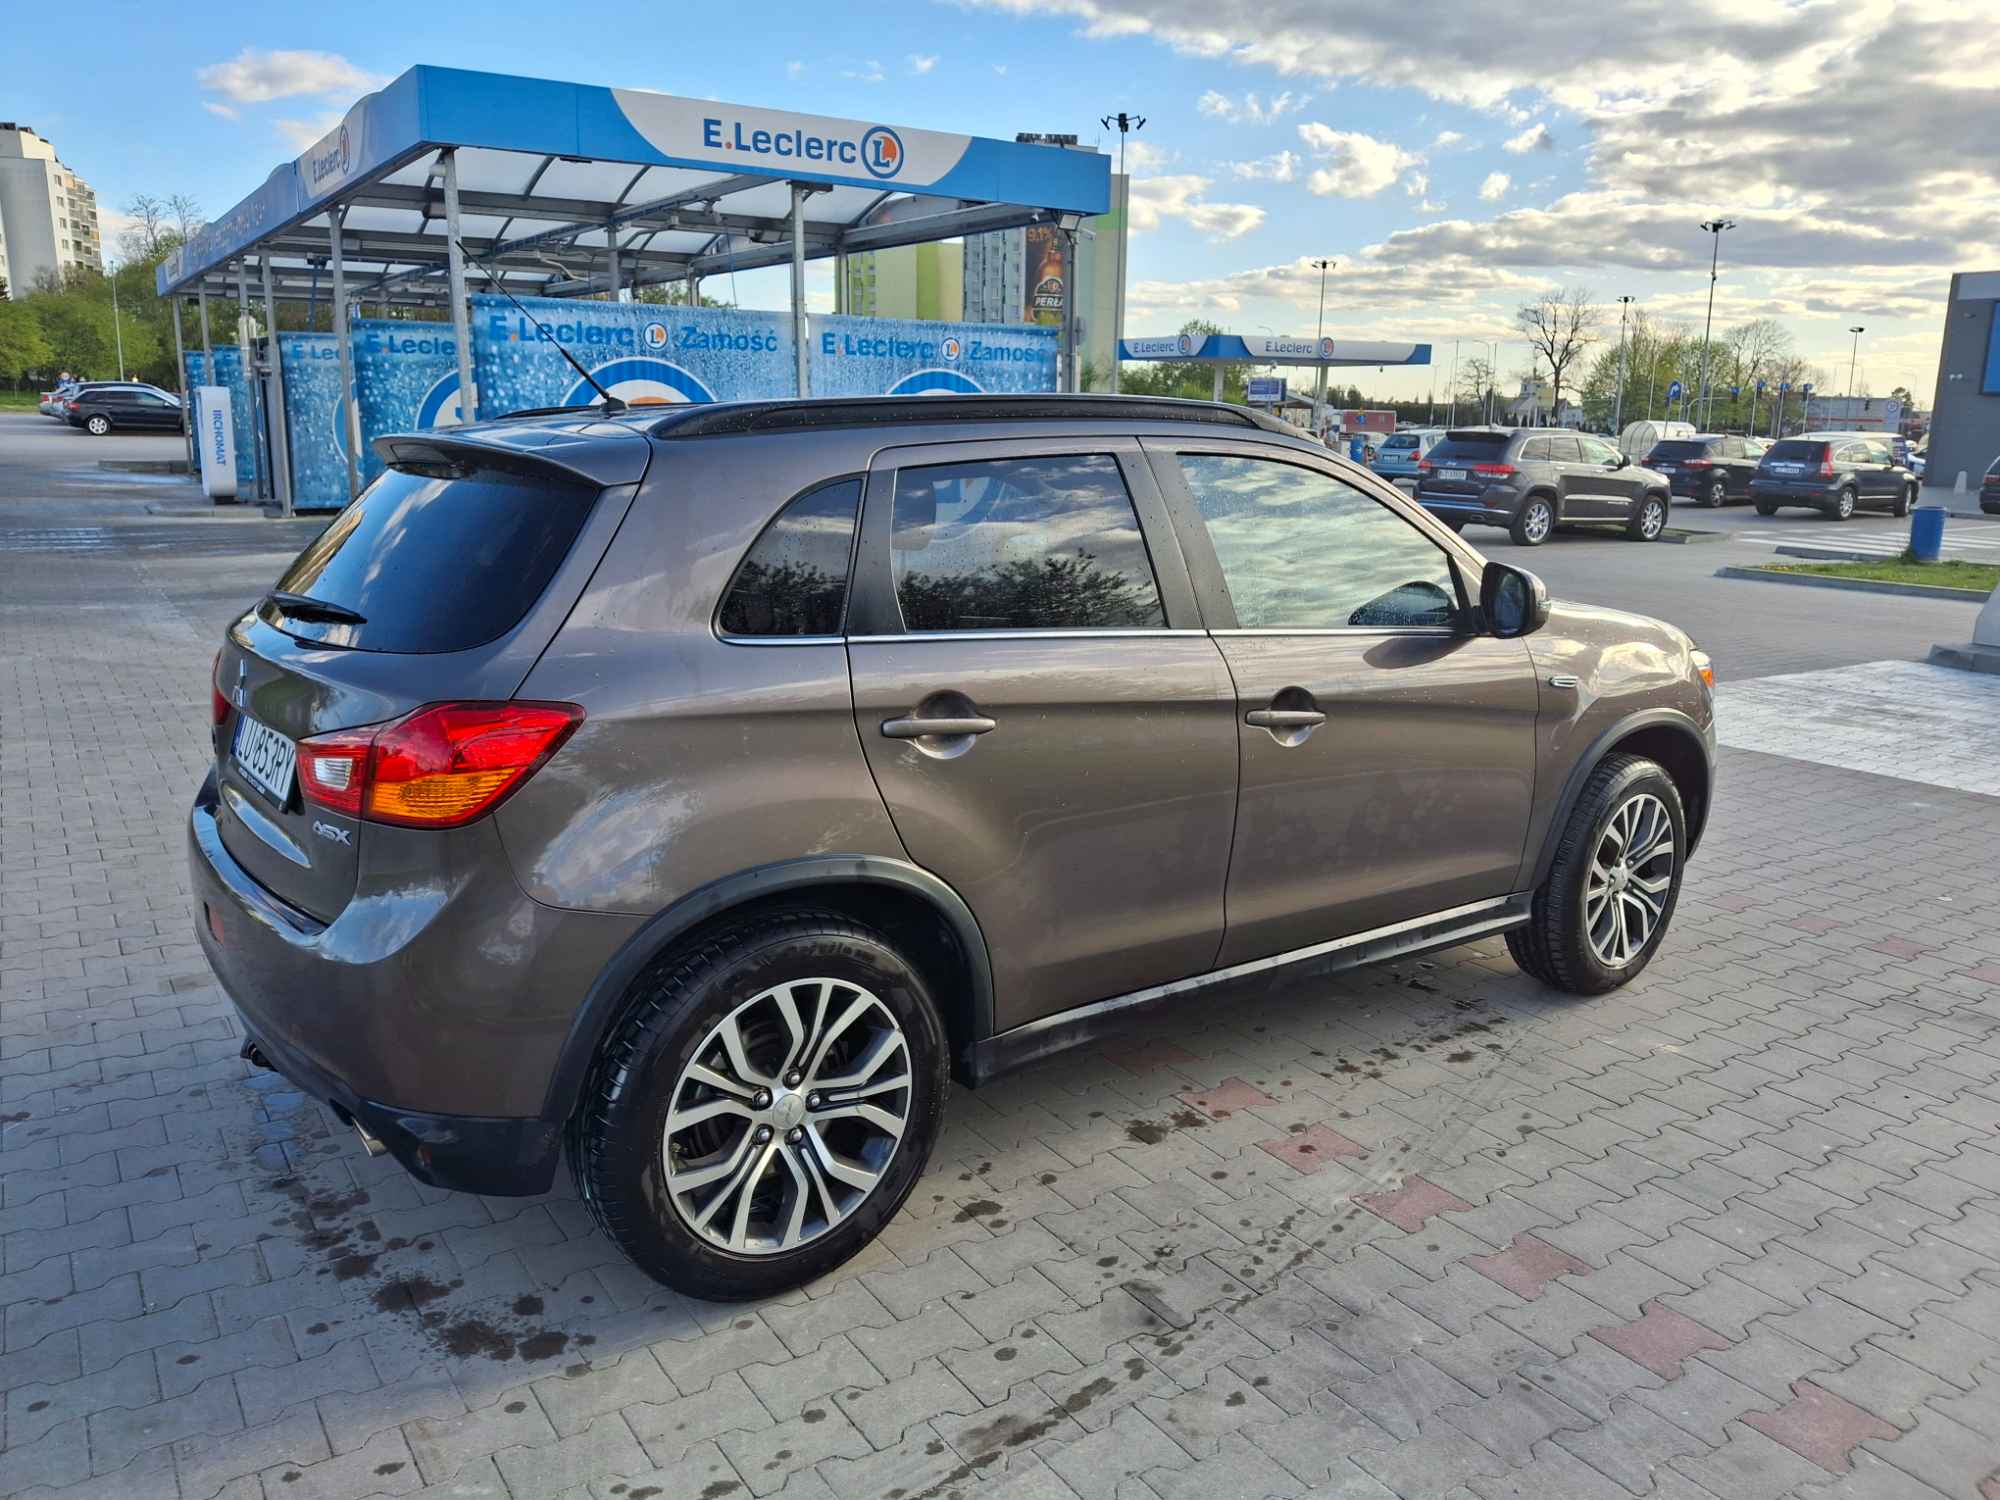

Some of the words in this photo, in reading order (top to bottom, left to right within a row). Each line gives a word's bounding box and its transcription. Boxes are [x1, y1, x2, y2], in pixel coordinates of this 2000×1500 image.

[703, 118, 857, 164] E.Leclerc
[366, 334, 456, 355] E.Lecle
[489, 315, 635, 346] E.Leclerc
[680, 326, 778, 352] Zamość
[822, 332, 934, 360] E.Leclerc
[1134, 342, 1175, 353] E.Leclerc
[1265, 341, 1312, 353] E.Leclerc
